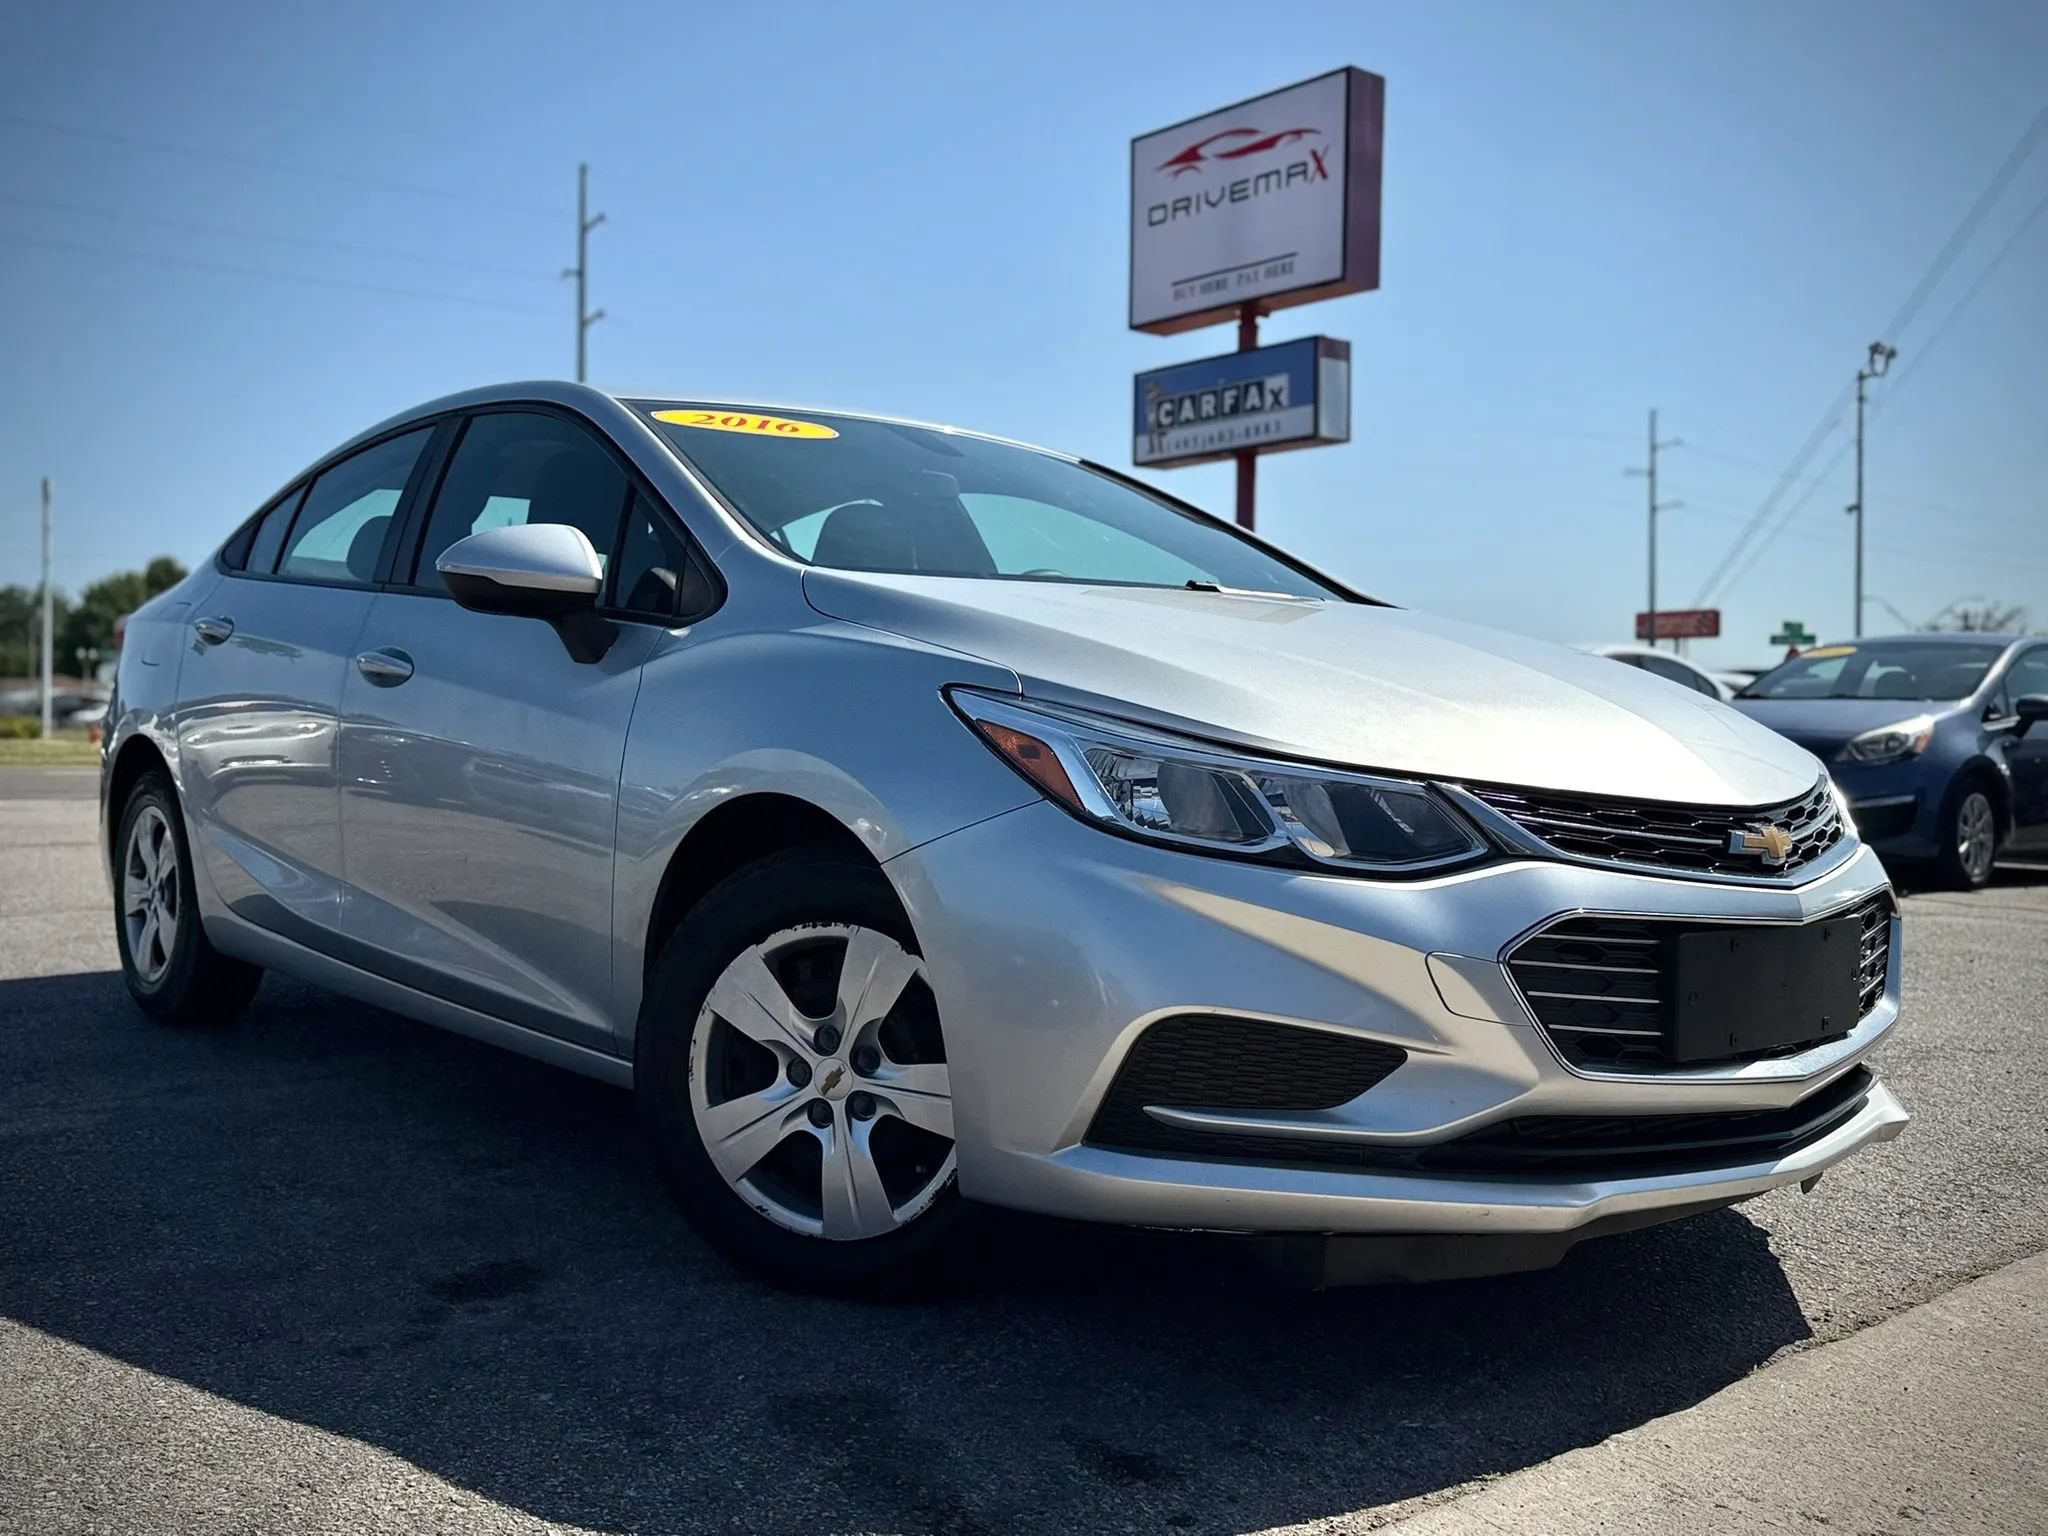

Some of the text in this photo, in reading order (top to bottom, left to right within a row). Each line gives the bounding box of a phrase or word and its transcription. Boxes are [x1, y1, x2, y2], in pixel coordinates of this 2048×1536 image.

[1147, 144, 1330, 227] DRIVEMAX
[690, 413, 800, 433] 2016
[1158, 384, 1284, 426] CARFAX
